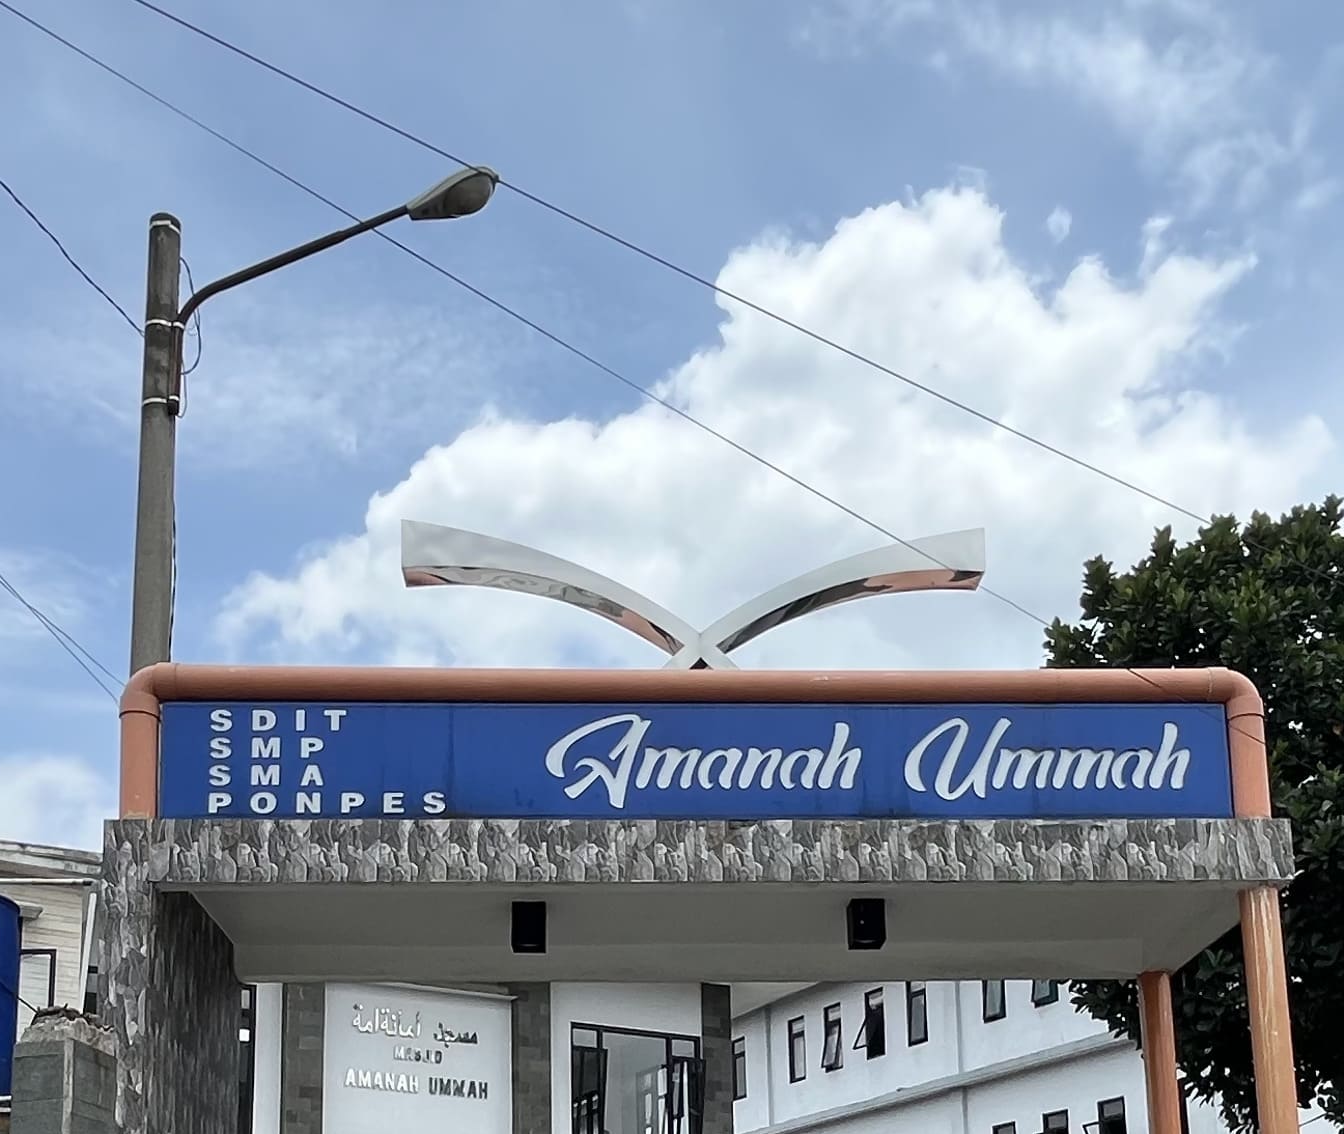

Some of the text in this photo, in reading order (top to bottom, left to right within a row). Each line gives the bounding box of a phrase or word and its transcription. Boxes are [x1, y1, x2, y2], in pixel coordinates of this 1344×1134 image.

[210, 710, 346, 732] SDIT
[210, 737, 324, 758] SMP
[546, 713, 1190, 809] Amanah Ummah
[209, 765, 323, 786] SMA
[208, 792, 445, 813] PONPES
[345, 1069, 488, 1099] AMANAH UMMAH
